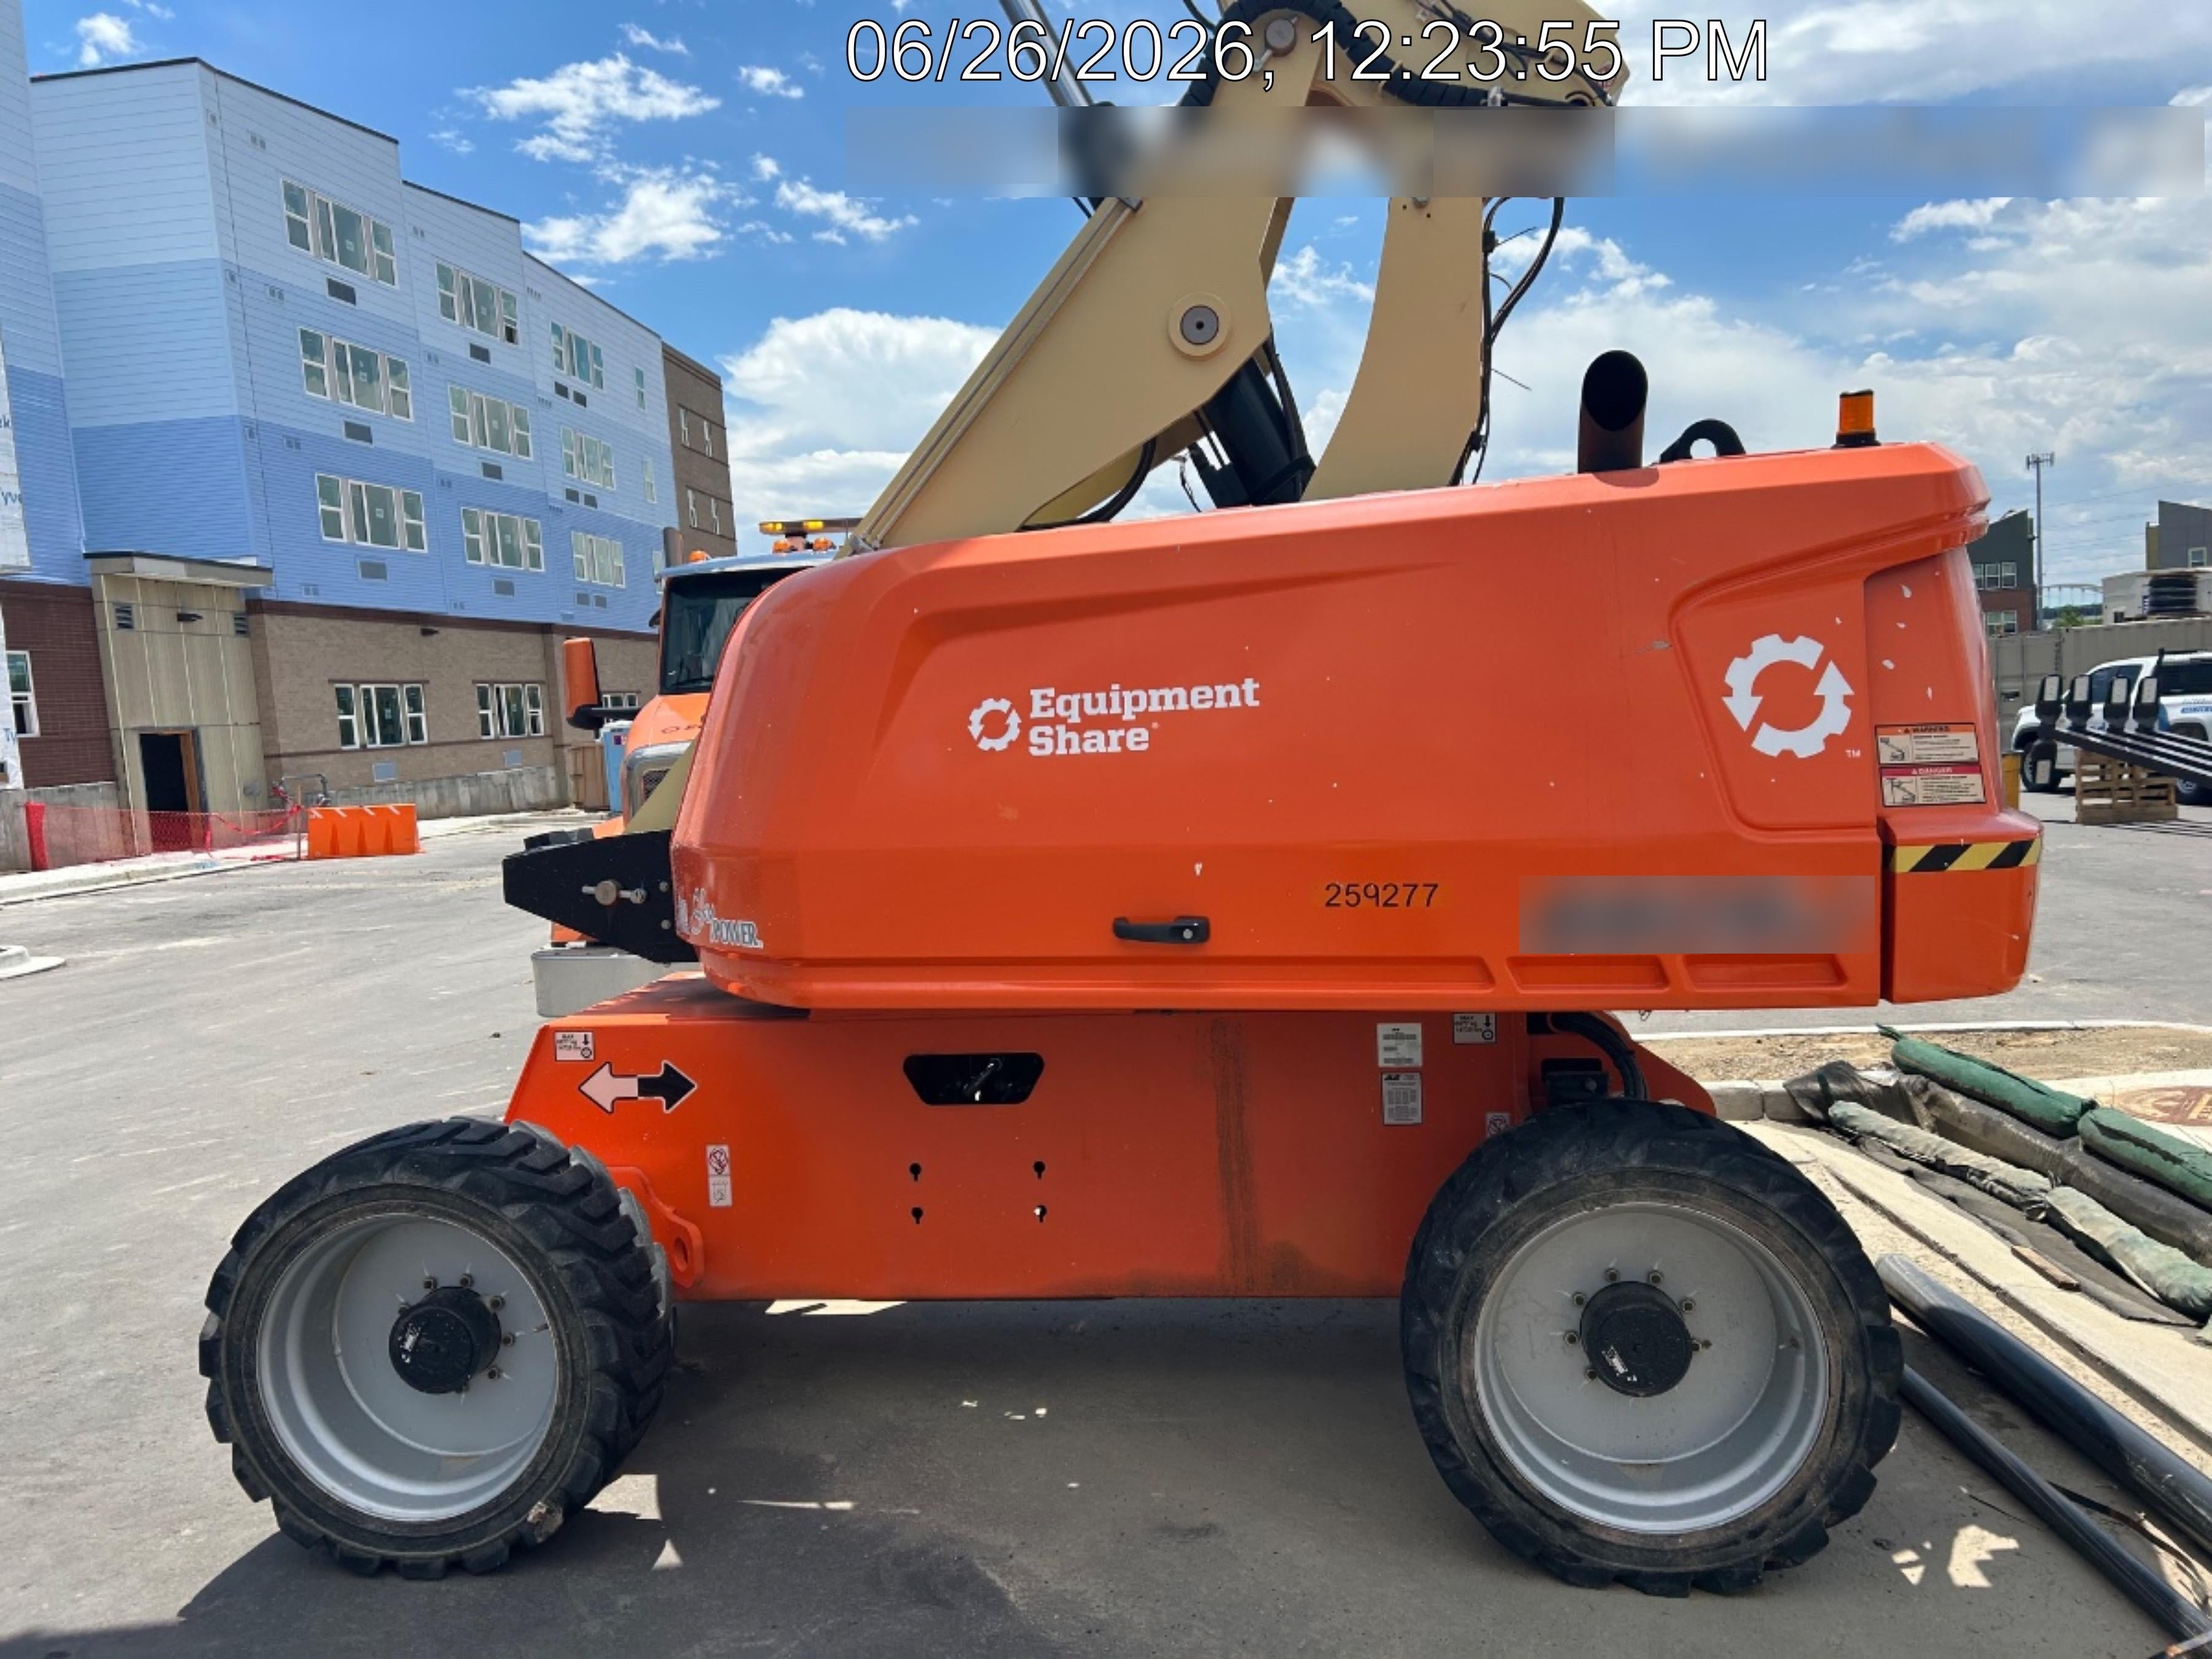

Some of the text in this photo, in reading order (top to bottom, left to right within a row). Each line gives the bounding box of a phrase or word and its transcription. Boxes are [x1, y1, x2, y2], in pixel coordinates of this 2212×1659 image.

[1029, 677, 1260, 723] Equipment
[1029, 724, 1150, 756] Share
[1845, 749, 1861, 758] TM
[1325, 882, 1439, 908] 259277
